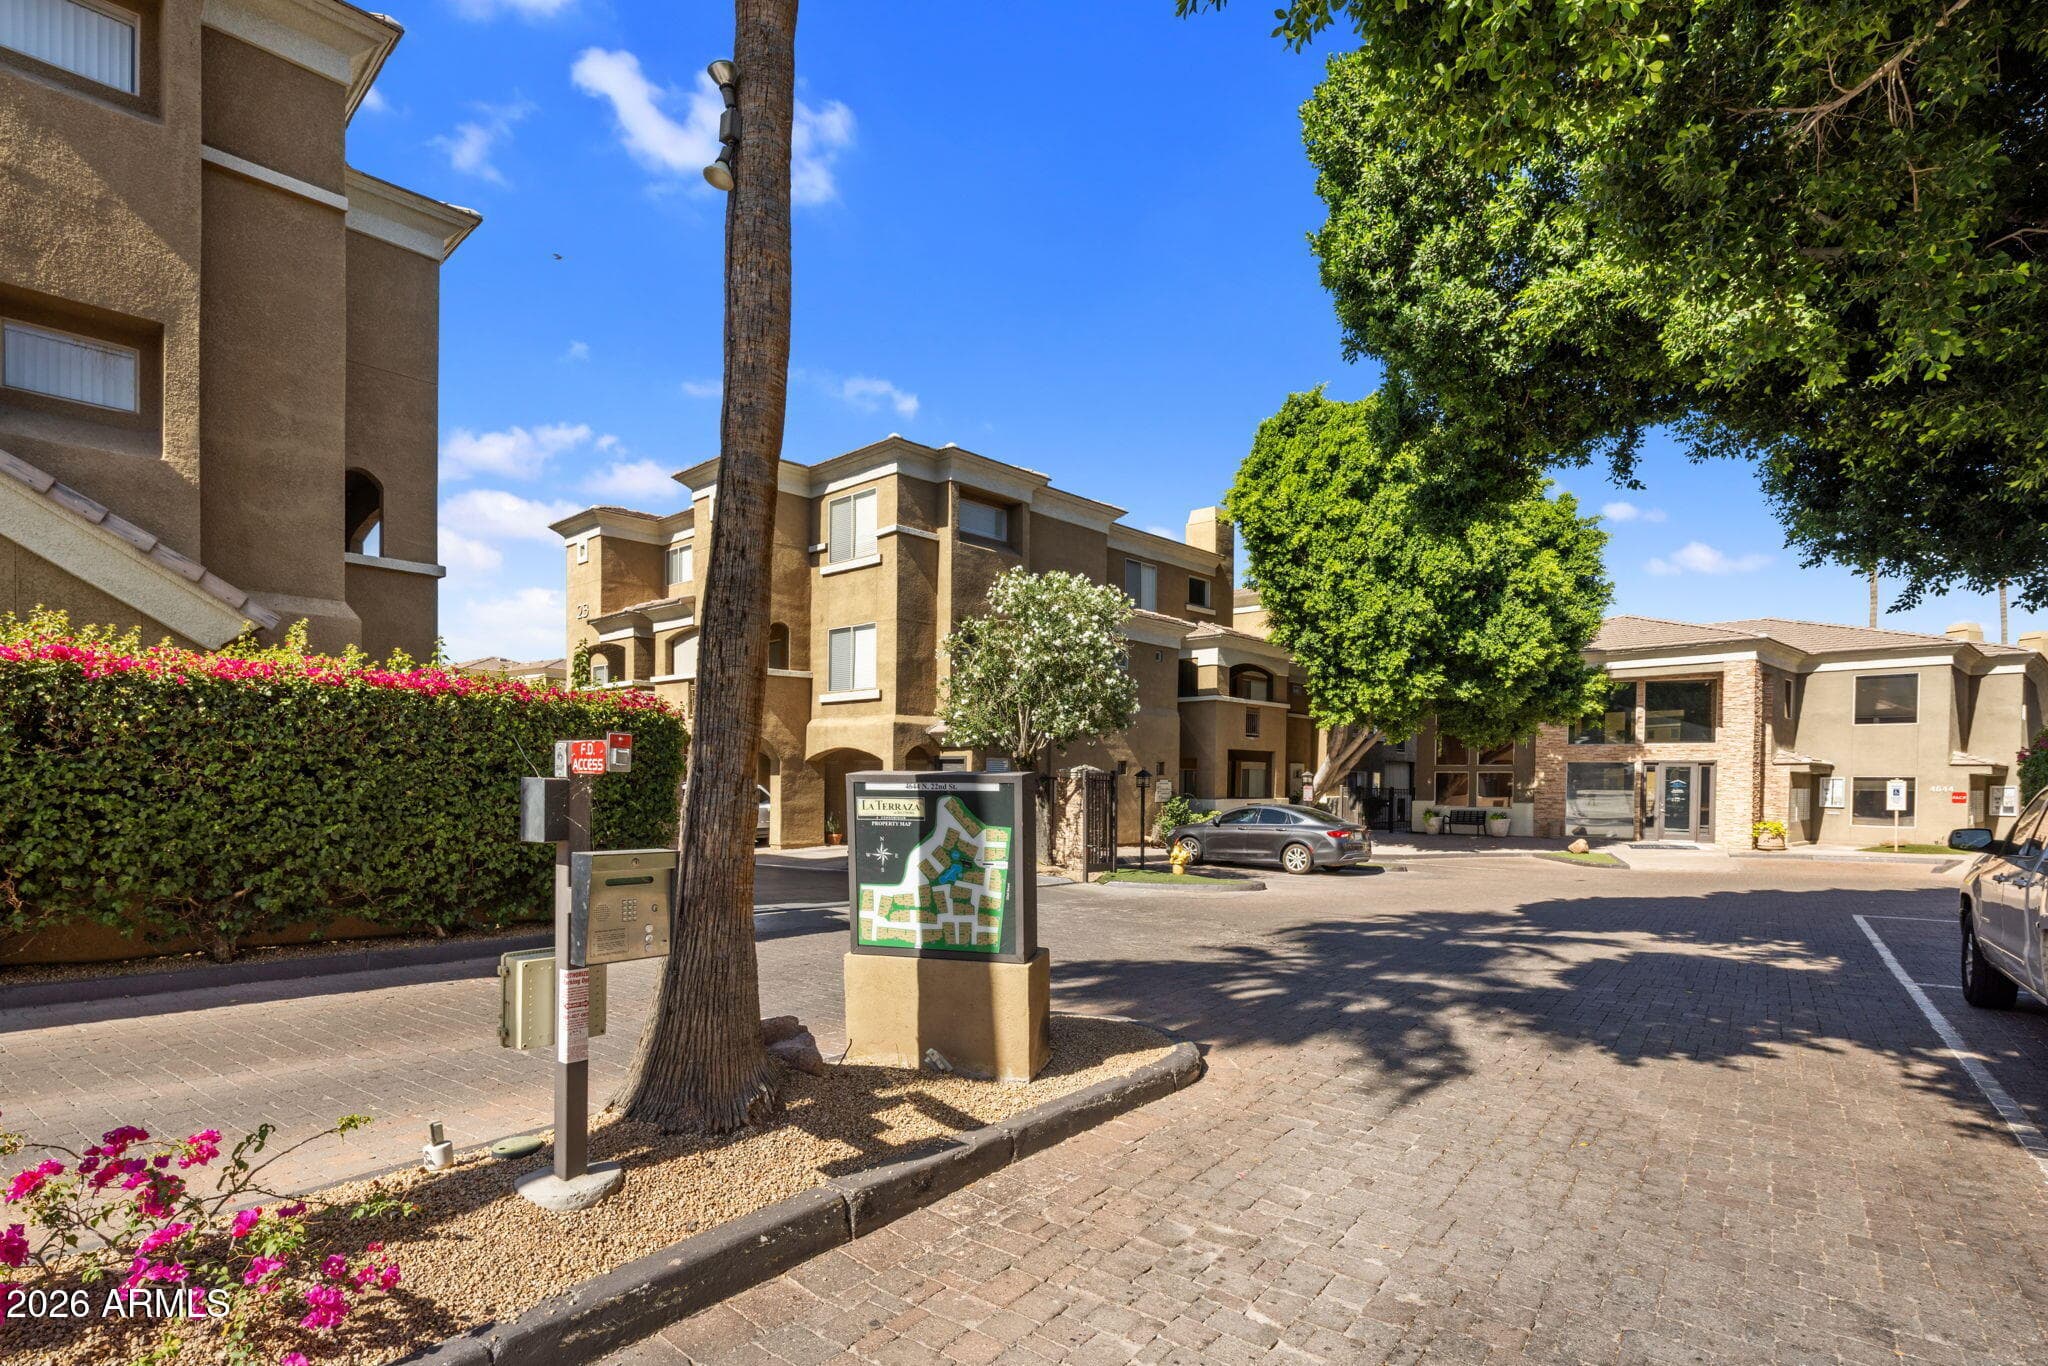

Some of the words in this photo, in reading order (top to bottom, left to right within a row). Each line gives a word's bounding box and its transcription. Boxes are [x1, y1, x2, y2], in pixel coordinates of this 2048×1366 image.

[580, 743, 596, 756] F.D.
[572, 758, 604, 771] ACCESS
[875, 800, 921, 811] TERRAZA
